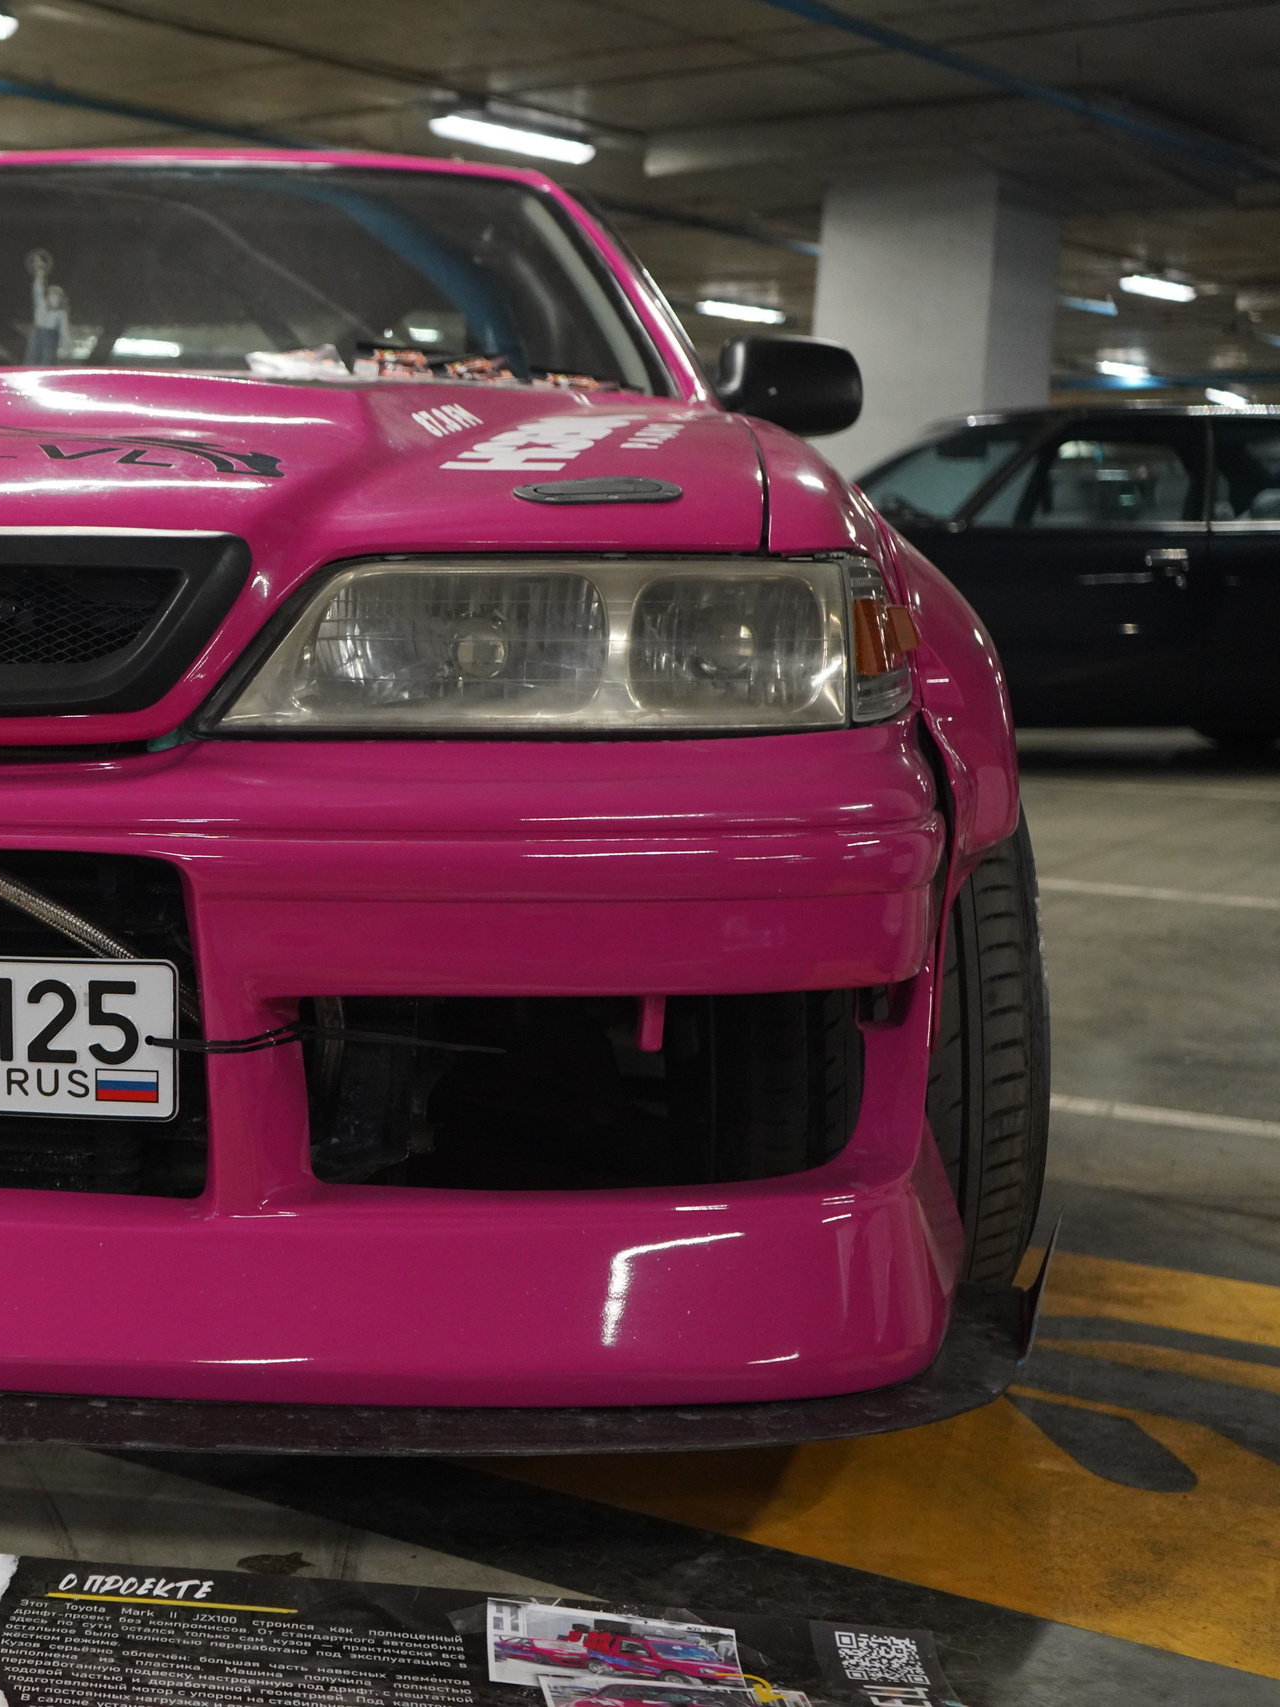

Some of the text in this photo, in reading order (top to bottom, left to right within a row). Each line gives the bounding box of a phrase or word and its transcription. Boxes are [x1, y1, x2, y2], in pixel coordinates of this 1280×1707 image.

[5, 1067, 91, 1098] RUS
[58, 1573, 214, 1600] О ПРОЕКТЕ
[9, 1616, 48, 1624] здесь
[82, 1622, 112, 1630] сути
[121, 1625, 174, 1634] остался
[184, 1631, 230, 1639] только
[273, 1639, 311, 1647] кузов
[342, 1644, 432, 1657] практически
[20, 1599, 48, 1607] Этот
[64, 1603, 106, 1613] Toyota
[120, 1608, 154, 1616] Mark
[192, 1614, 237, 1623] JZX100
[252, 1620, 314, 1630] строился
[368, 1629, 462, 1643] полноценный
[281, 1631, 375, 1644] стандартного
[382, 1639, 464, 1651] автомобиля
[0, 1638, 40, 1648] Кузов
[199, 1656, 260, 1667] большая
[268, 1663, 308, 1671] часть
[317, 1667, 386, 1678] навесных
[395, 1674, 470, 1685] элементов
[5, 1623, 76, 1634] остальное
[84, 1629, 118, 1638] было
[126, 1634, 202, 1645] полностью
[209, 1640, 308, 1655] переработано
[350, 1653, 451, 1667] эксплуатацию
[0, 1648, 78, 1659] выполнена
[225, 1667, 283, 1677] Машина
[304, 1675, 371, 1686] получила
[392, 1682, 471, 1694] полностью
[1, 1656, 120, 1672] переработанную
[198, 1674, 293, 1688] настроенную
[394, 1691, 473, 1703] нештатной
[3, 1665, 62, 1676] ходовой
[71, 1672, 123, 1681] частью
[147, 1678, 251, 1693] доработанной
[355, 1696, 384, 1705] Под
[7, 1674, 127, 1691] подготовленный
[131, 1686, 173, 1695] мотор
[190, 1691, 242, 1701] упором
